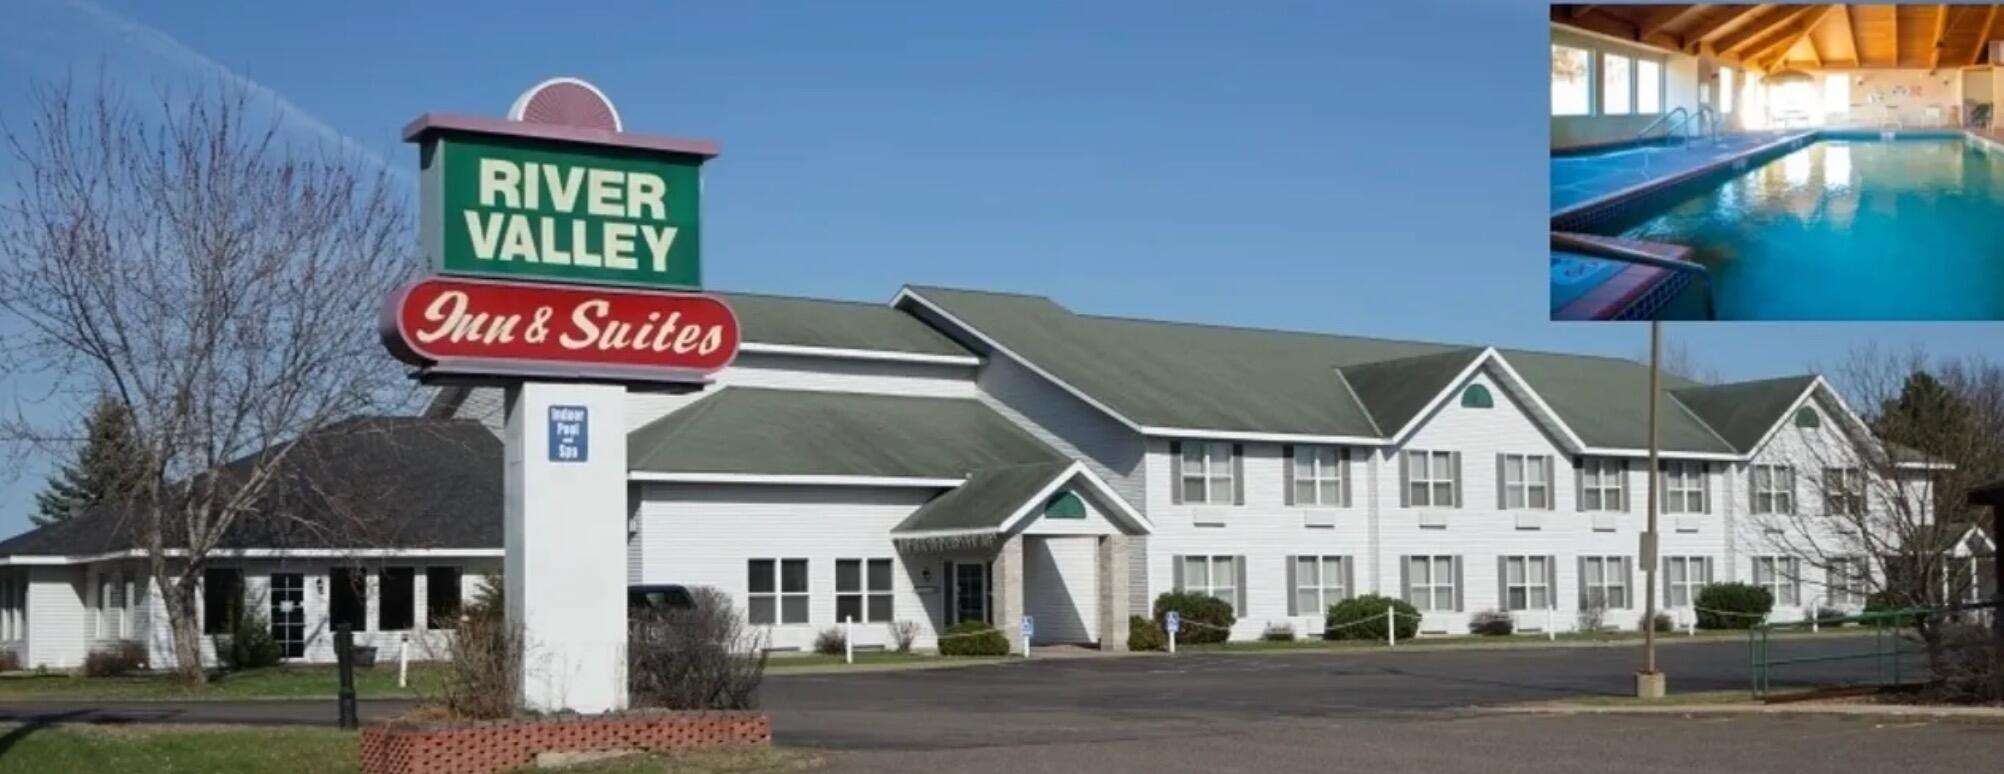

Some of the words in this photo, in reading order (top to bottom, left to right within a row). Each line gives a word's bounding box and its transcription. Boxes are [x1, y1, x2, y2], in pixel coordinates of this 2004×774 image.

[480, 158, 666, 219] RIVER
[464, 210, 678, 272] VALLEY
[416, 290, 521, 345] Inn
[524, 306, 553, 343] &
[559, 300, 723, 355] Suites
[559, 444, 578, 459] Spa
